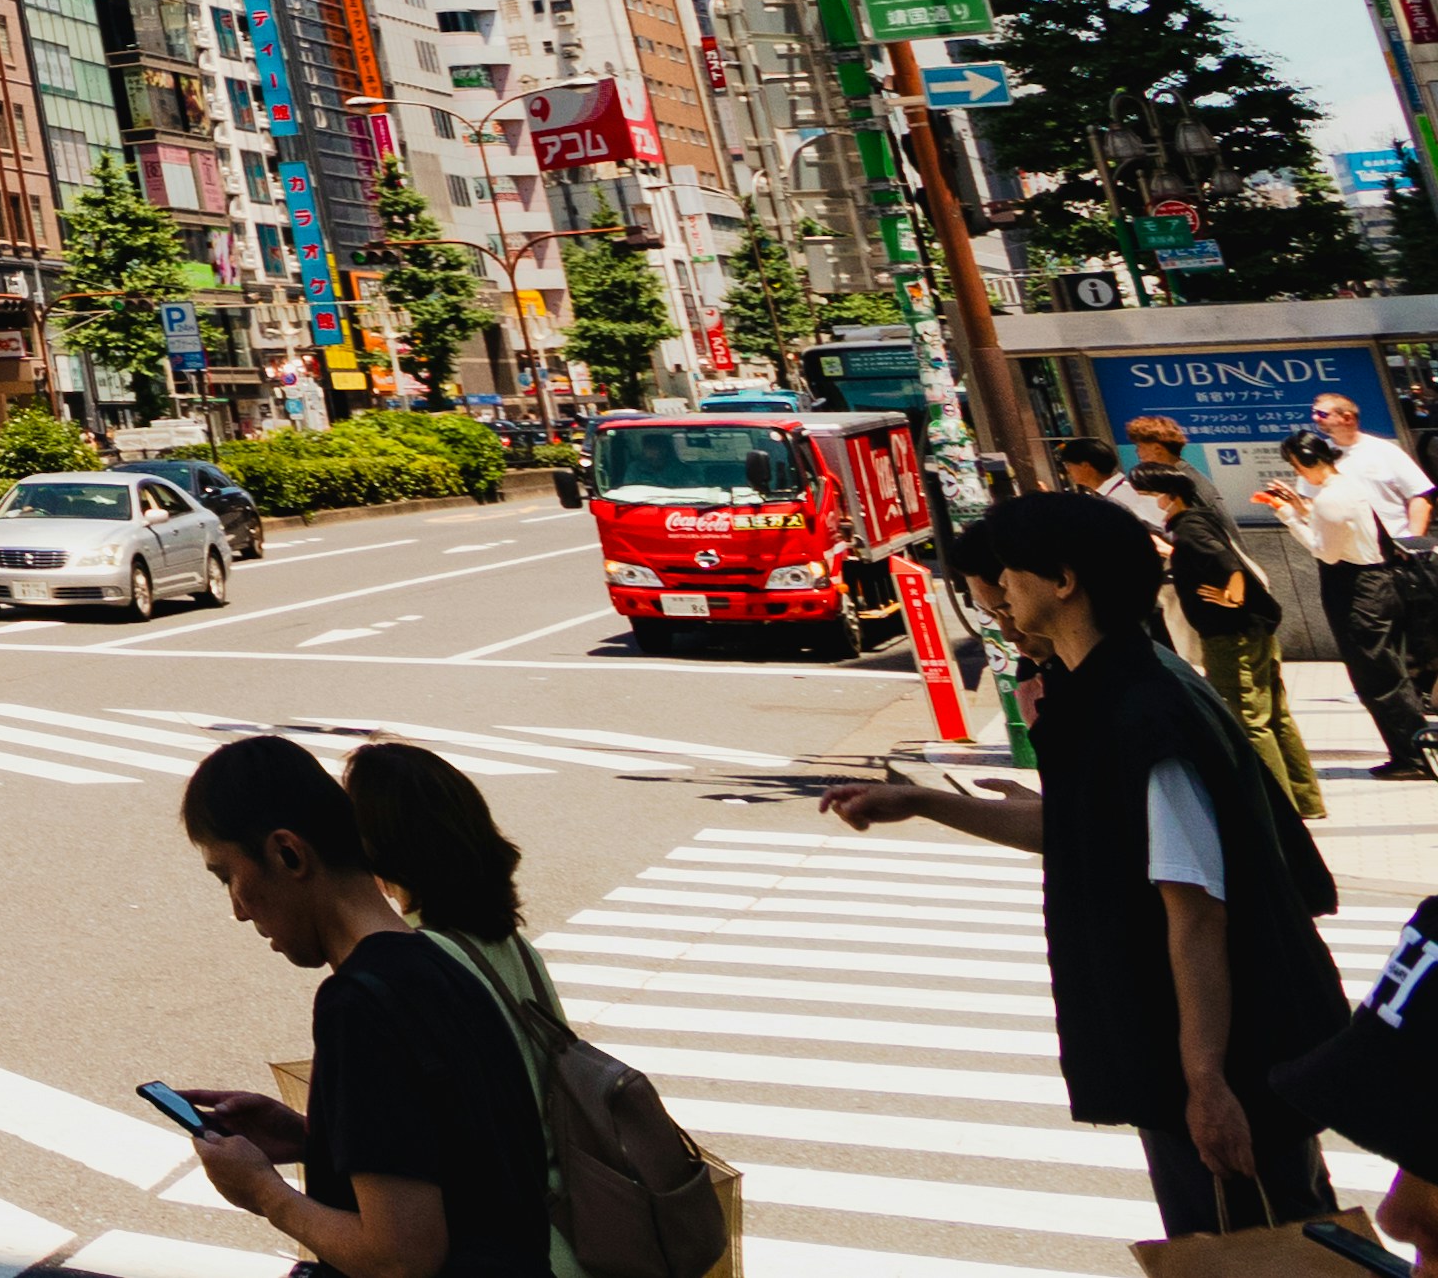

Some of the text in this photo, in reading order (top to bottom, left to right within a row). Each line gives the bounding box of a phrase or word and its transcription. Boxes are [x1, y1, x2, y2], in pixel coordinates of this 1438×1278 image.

[537, 129, 610, 166] アコム
[287, 175, 338, 332] カラオケ館
[1129, 357, 1342, 390] SUBNADE
[1194, 389, 1285, 404] 新宿サブナード
[1189, 410, 1306, 423] ファッション レストラン
[733, 514, 805, 530] 高圧ガス
